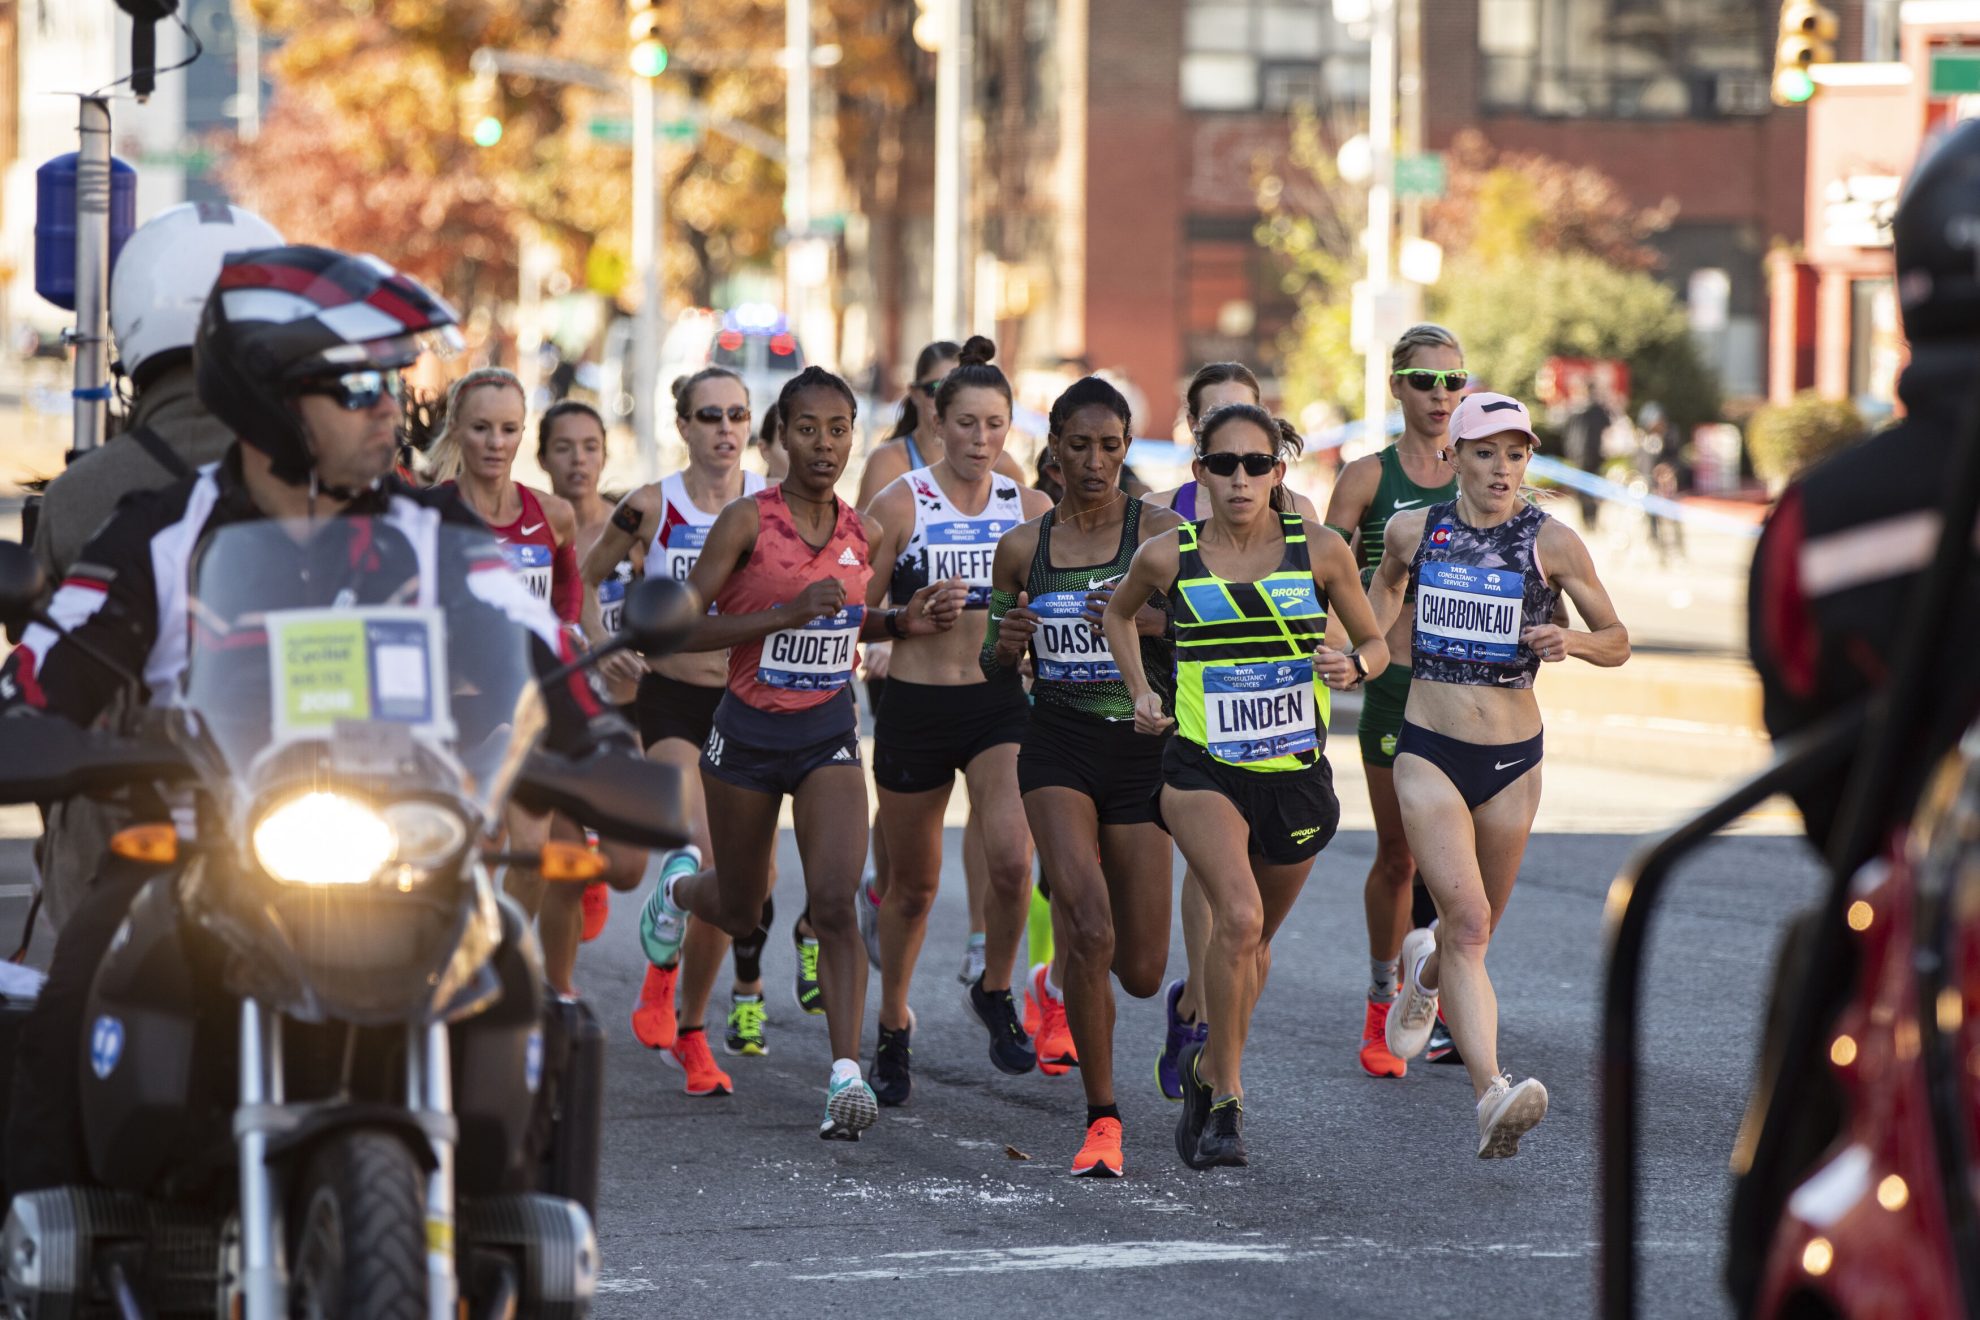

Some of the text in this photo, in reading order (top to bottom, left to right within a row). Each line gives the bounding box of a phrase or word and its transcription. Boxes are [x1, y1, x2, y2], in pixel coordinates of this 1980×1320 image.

[936, 549, 996, 580] KIEFF
[1450, 566, 1468, 575] TATA
[1437, 571, 1478, 582] CONSULTANCY
[1443, 578, 1470, 588] SERVICES
[1484, 583, 1502, 592] TATA
[1271, 587, 1311, 598] BROOKS
[1422, 593, 1514, 636] CHARBONEAU
[1042, 623, 1111, 654] DASK
[770, 632, 850, 666] GUDETA
[1234, 668, 1255, 676] TATA
[1223, 673, 1268, 683] CONSULTANCY
[1275, 674, 1295, 684] TATA
[1217, 690, 1304, 733] LINDEN
